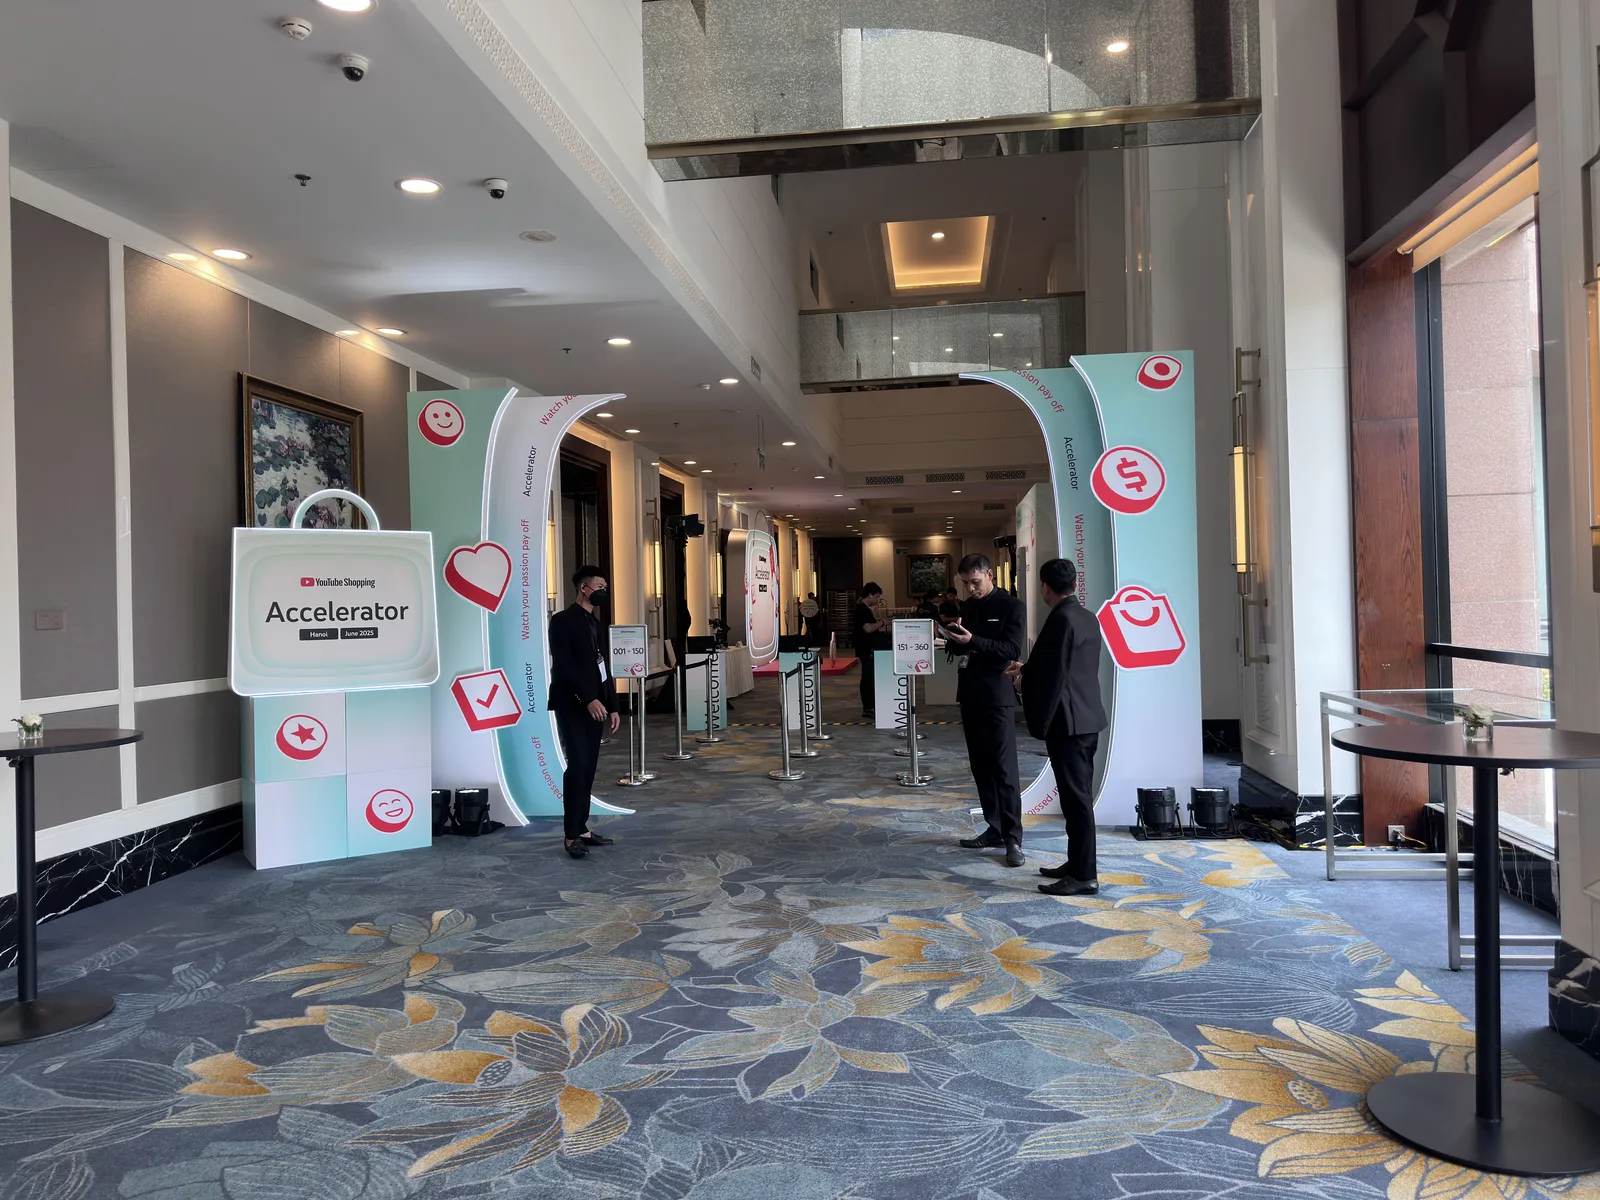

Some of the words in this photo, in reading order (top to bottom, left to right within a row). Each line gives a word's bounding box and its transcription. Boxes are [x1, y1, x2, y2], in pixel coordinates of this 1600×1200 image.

[1012, 369, 1040, 386] ssion
[1037, 384, 1054, 401] pay
[1050, 400, 1065, 413] off
[540, 401, 563, 426] Watch
[522, 445, 537, 497] Accelerator
[1064, 436, 1079, 490] Accelerator
[520, 519, 529, 532] off
[1074, 514, 1085, 545] Watch
[522, 535, 530, 550] pay
[520, 553, 530, 586] passion
[1074, 547, 1084, 568] your
[315, 577, 343, 587] YouTube
[344, 577, 376, 588] Shopping
[1076, 571, 1088, 607] passion
[265, 600, 409, 623] Accelerator
[522, 589, 530, 612] your
[521, 612, 529, 640] Watch
[613, 647, 626, 655] 001
[632, 647, 644, 655] 150
[897, 643, 908, 651] 151
[914, 643, 929, 651] 360
[525, 662, 536, 713] Accelerator
[893, 676, 908, 730] Welco
[531, 736, 541, 748] off
[536, 751, 547, 767] pay
[541, 766, 564, 800] passion
[1025, 793, 1053, 815] passio
